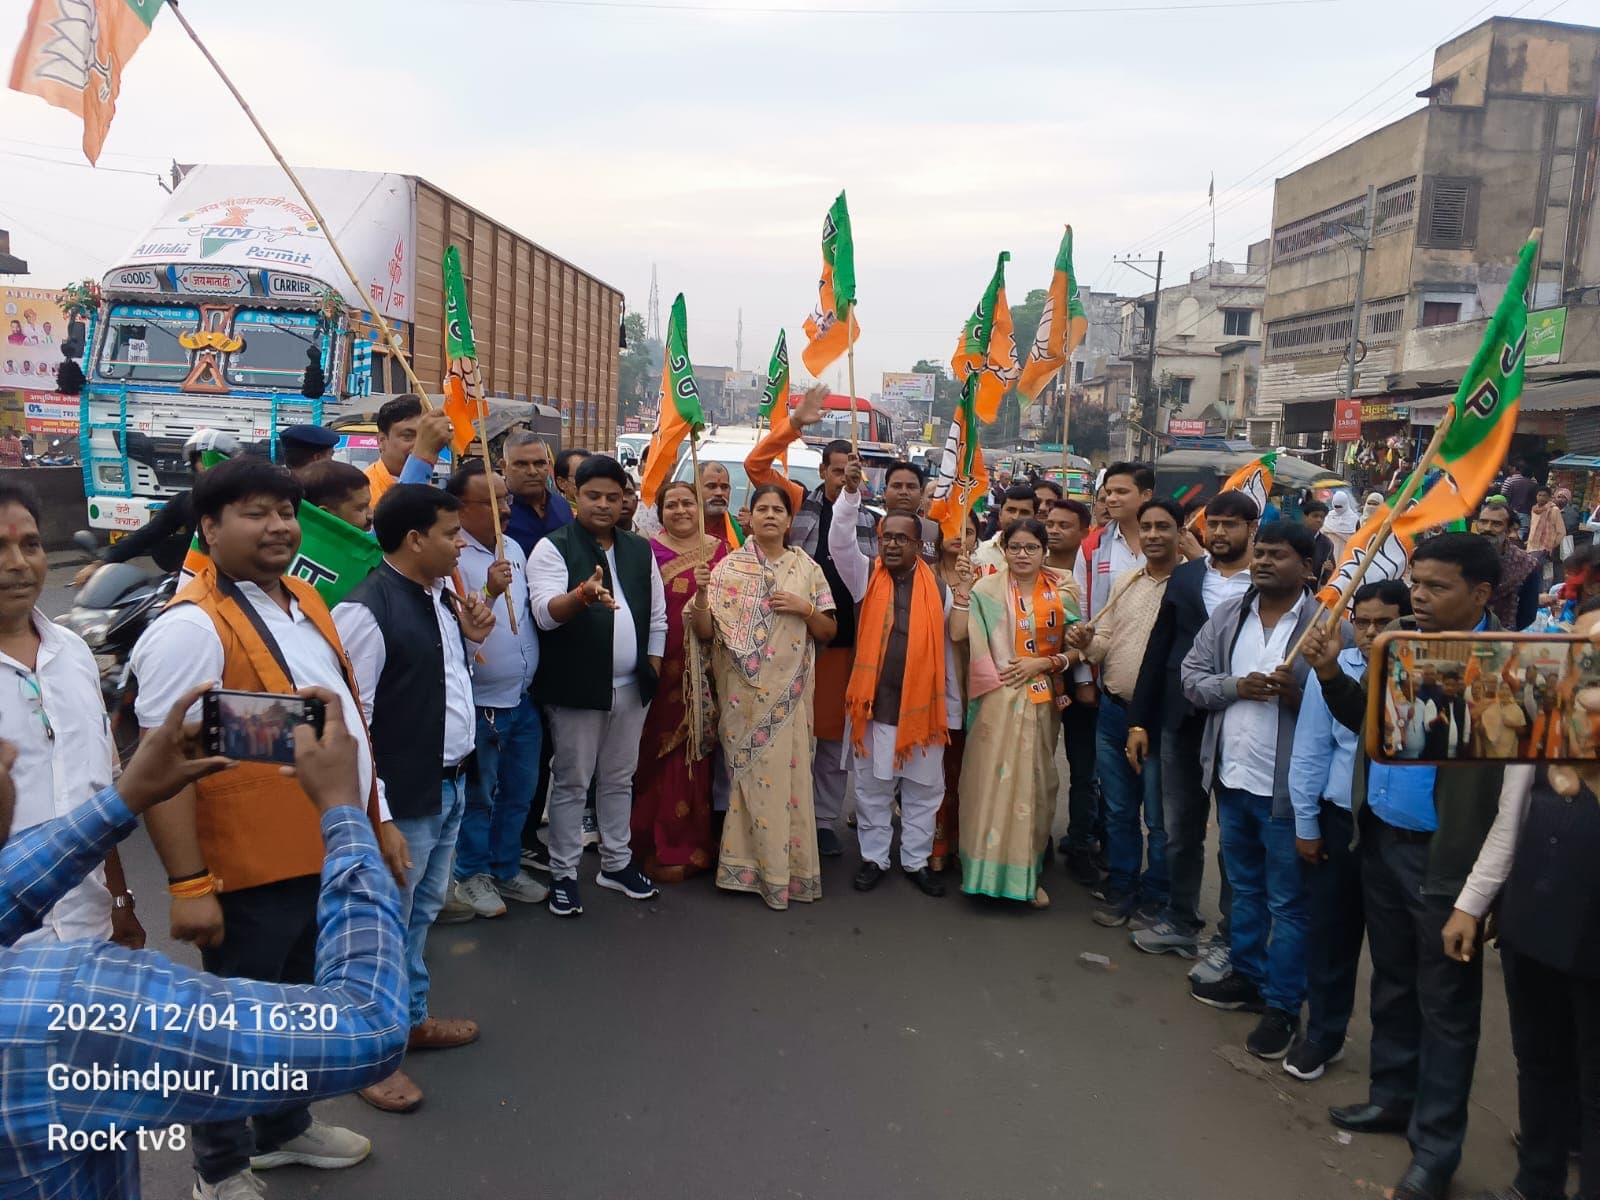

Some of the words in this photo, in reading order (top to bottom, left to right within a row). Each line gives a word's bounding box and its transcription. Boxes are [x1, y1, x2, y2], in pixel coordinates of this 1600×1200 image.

[205, 227, 254, 239] PCM
[136, 243, 155, 256] All
[156, 241, 189, 255] India
[245, 245, 312, 264] Permit
[120, 271, 152, 285] GOODS
[273, 278, 311, 293] CARRIER
